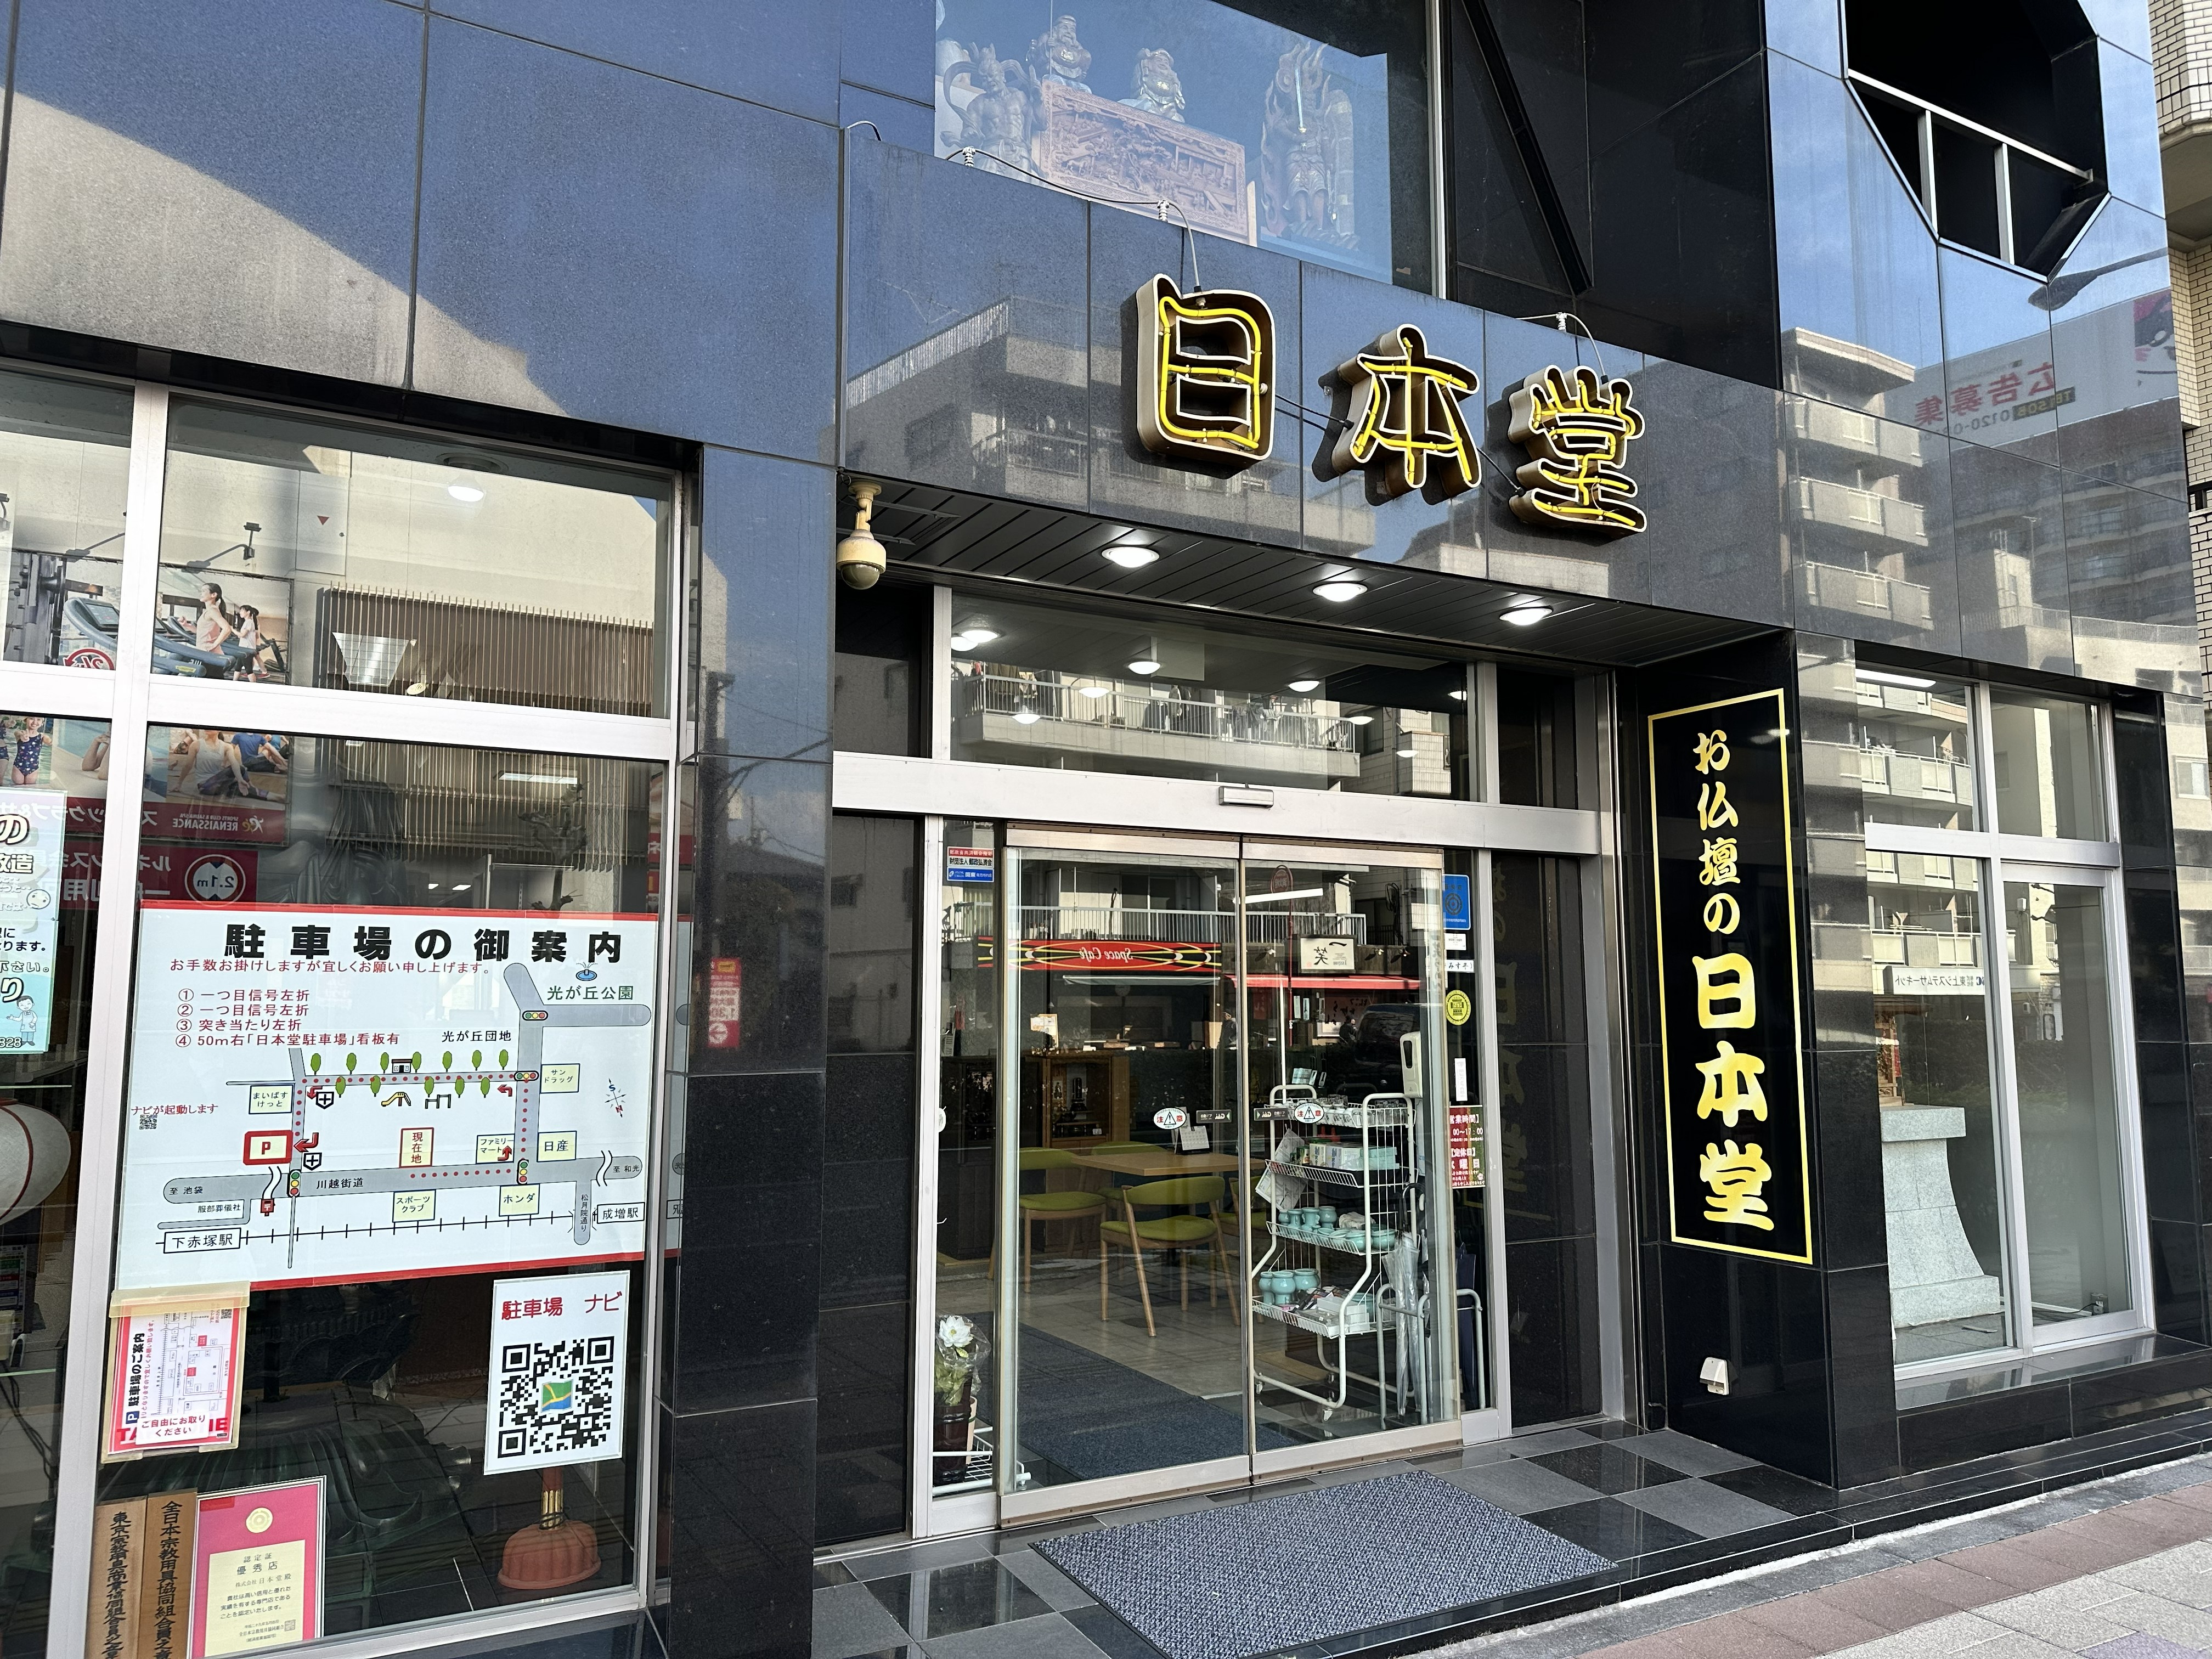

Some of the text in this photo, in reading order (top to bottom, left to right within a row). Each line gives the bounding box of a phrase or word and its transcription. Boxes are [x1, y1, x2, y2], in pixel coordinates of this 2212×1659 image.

[1137, 273, 1647, 539] 日本堂
[0, 941, 46, 951] ります。
[223, 923, 622, 963] 駐車場の御案内
[170, 959, 489, 974] お手数お掛けしますが宜しくお願い申し上げます。
[201, 989, 310, 1002] 一つ目信号左折
[547, 985, 634, 1001] 光が丘公園
[200, 1004, 309, 1017] 一つ目信号左折
[199, 1019, 302, 1031] 突き当たり左折
[198, 1032, 400, 1046] 50m右「日本堂駐車場」看板有
[442, 1030, 511, 1042] 光が丘団地
[131, 1104, 218, 1115] ナビが起動します
[261, 1141, 271, 1155] P
[411, 1132, 424, 1164] 現在地
[480, 1137, 515, 1146] ファミリー
[544, 1139, 569, 1152] 日産
[316, 1177, 364, 1189] 川越街道
[183, 1186, 204, 1195] 池袋
[396, 1196, 431, 1204] スポーツ
[503, 1193, 535, 1204] ホンダ
[198, 1204, 241, 1214] 服部葬儀社
[402, 1204, 424, 1213] クラブ
[580, 1194, 589, 1232] 松月院通り
[602, 1207, 639, 1220] 成増駅
[172, 1233, 233, 1249] 下赤塚駅
[501, 1290, 623, 1321] 駐車場 ナビ
[128, 1332, 145, 1407] 駐車場のご案内
[141, 1414, 206, 1429] ご自由にお取り
[155, 1427, 192, 1437] ください
[243, 1552, 272, 1563] 認定証
[236, 1561, 278, 1576] 優秀店
